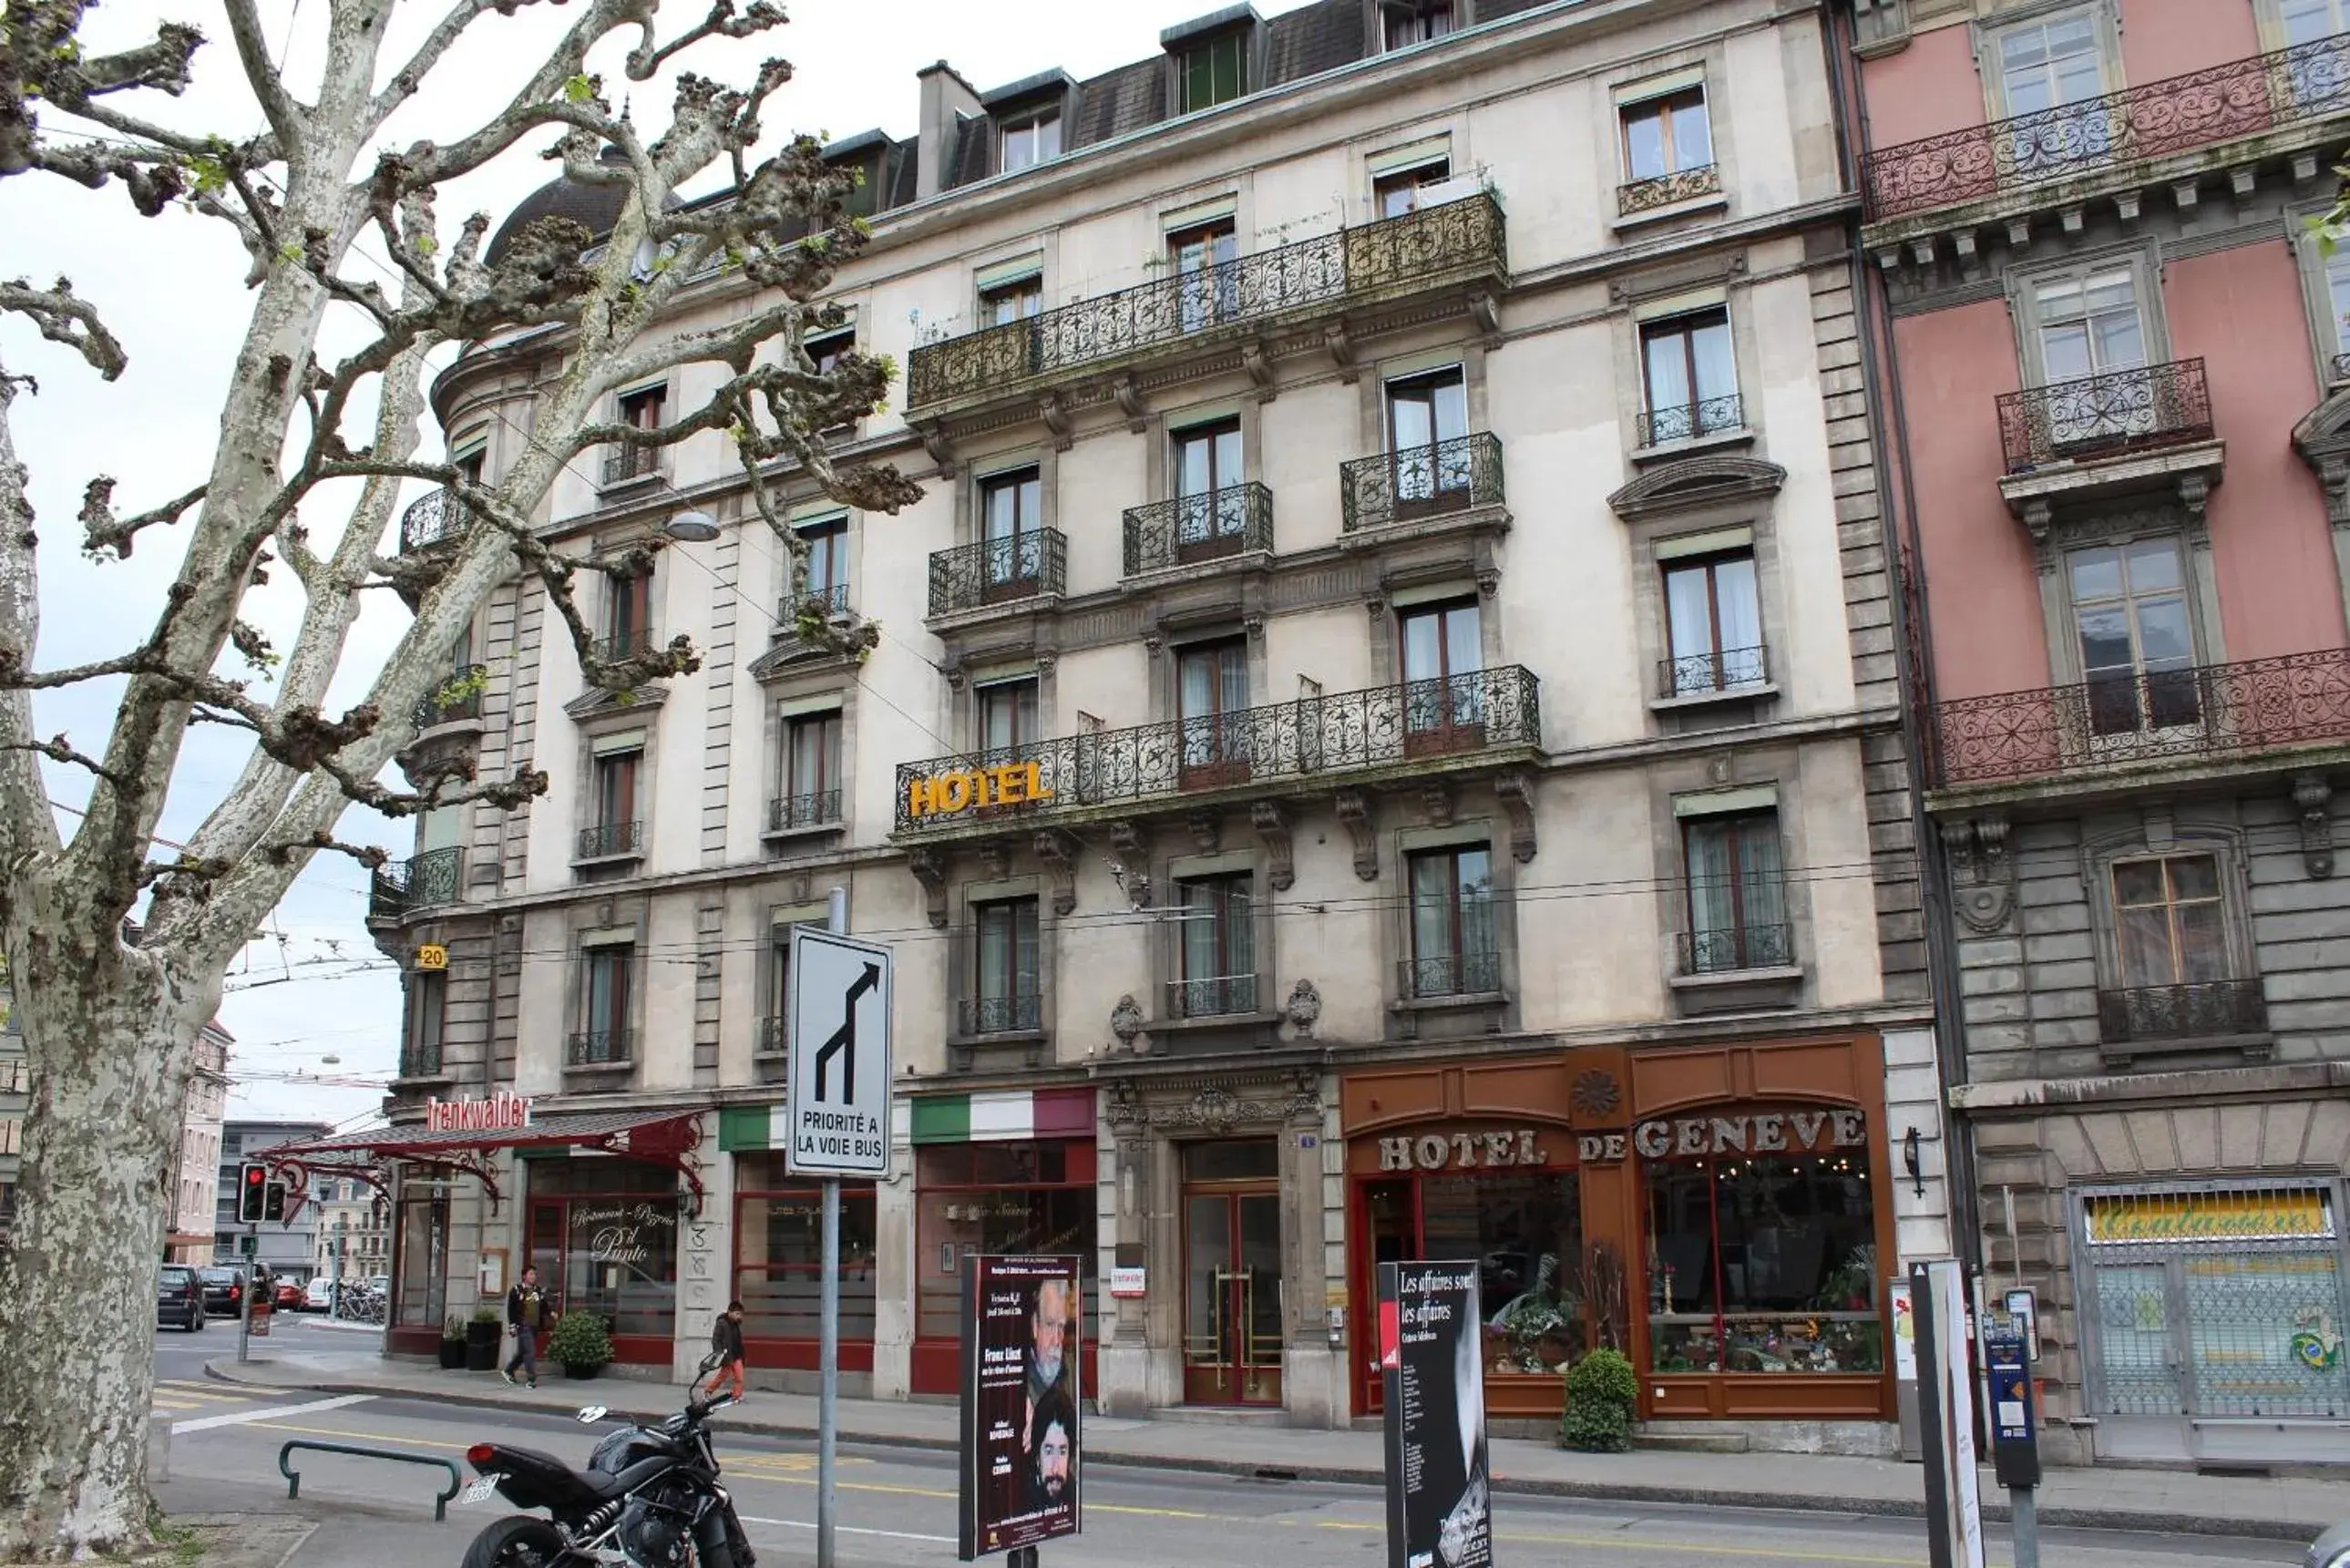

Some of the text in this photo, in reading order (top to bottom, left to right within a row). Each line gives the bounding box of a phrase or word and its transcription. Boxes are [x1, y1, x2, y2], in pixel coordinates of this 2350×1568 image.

[909, 760, 1054, 817] HOTEL
[424, 950, 443, 965] 20
[803, 1111, 878, 1133] PRIORITÉ A
[797, 1134, 882, 1158] LA VOIE BUS
[1379, 1109, 1866, 1172] HOTEL DE GENEVE
[592, 1225, 648, 1262] Punto
[1401, 1271, 1417, 1294] Les
[1419, 1269, 1453, 1299] affaires
[1401, 1299, 1452, 1329] les affaires
